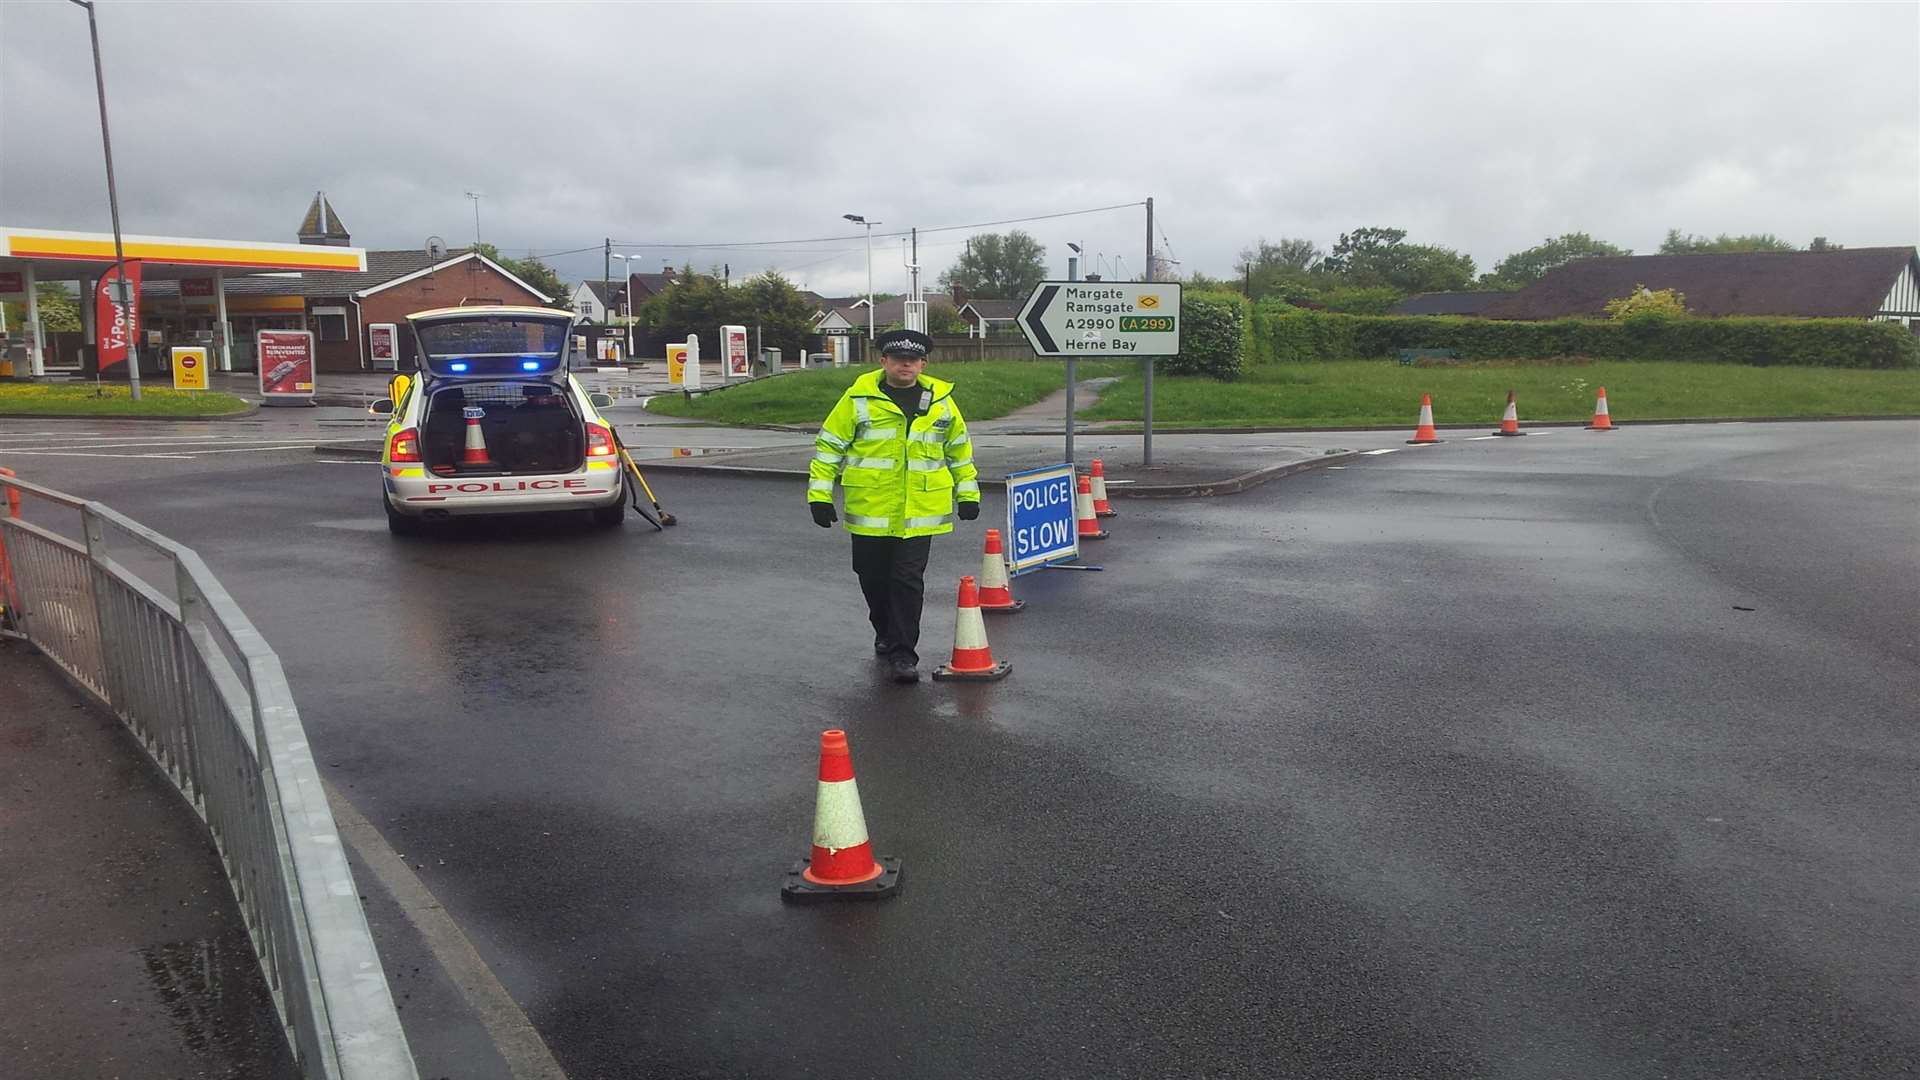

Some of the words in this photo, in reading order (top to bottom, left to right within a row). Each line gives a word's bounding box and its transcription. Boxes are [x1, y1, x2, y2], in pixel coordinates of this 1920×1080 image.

[1066, 288, 1124, 301] Margate
[1066, 302, 1134, 314] Ramsgate
[111, 303, 125, 349] V-Pow
[1066, 339, 1107, 350] Herne
[1112, 339, 1137, 352] Bay
[428, 478, 588, 494] POLICE
[1014, 482, 1068, 513] POLICE
[1018, 518, 1068, 554] SLOW
